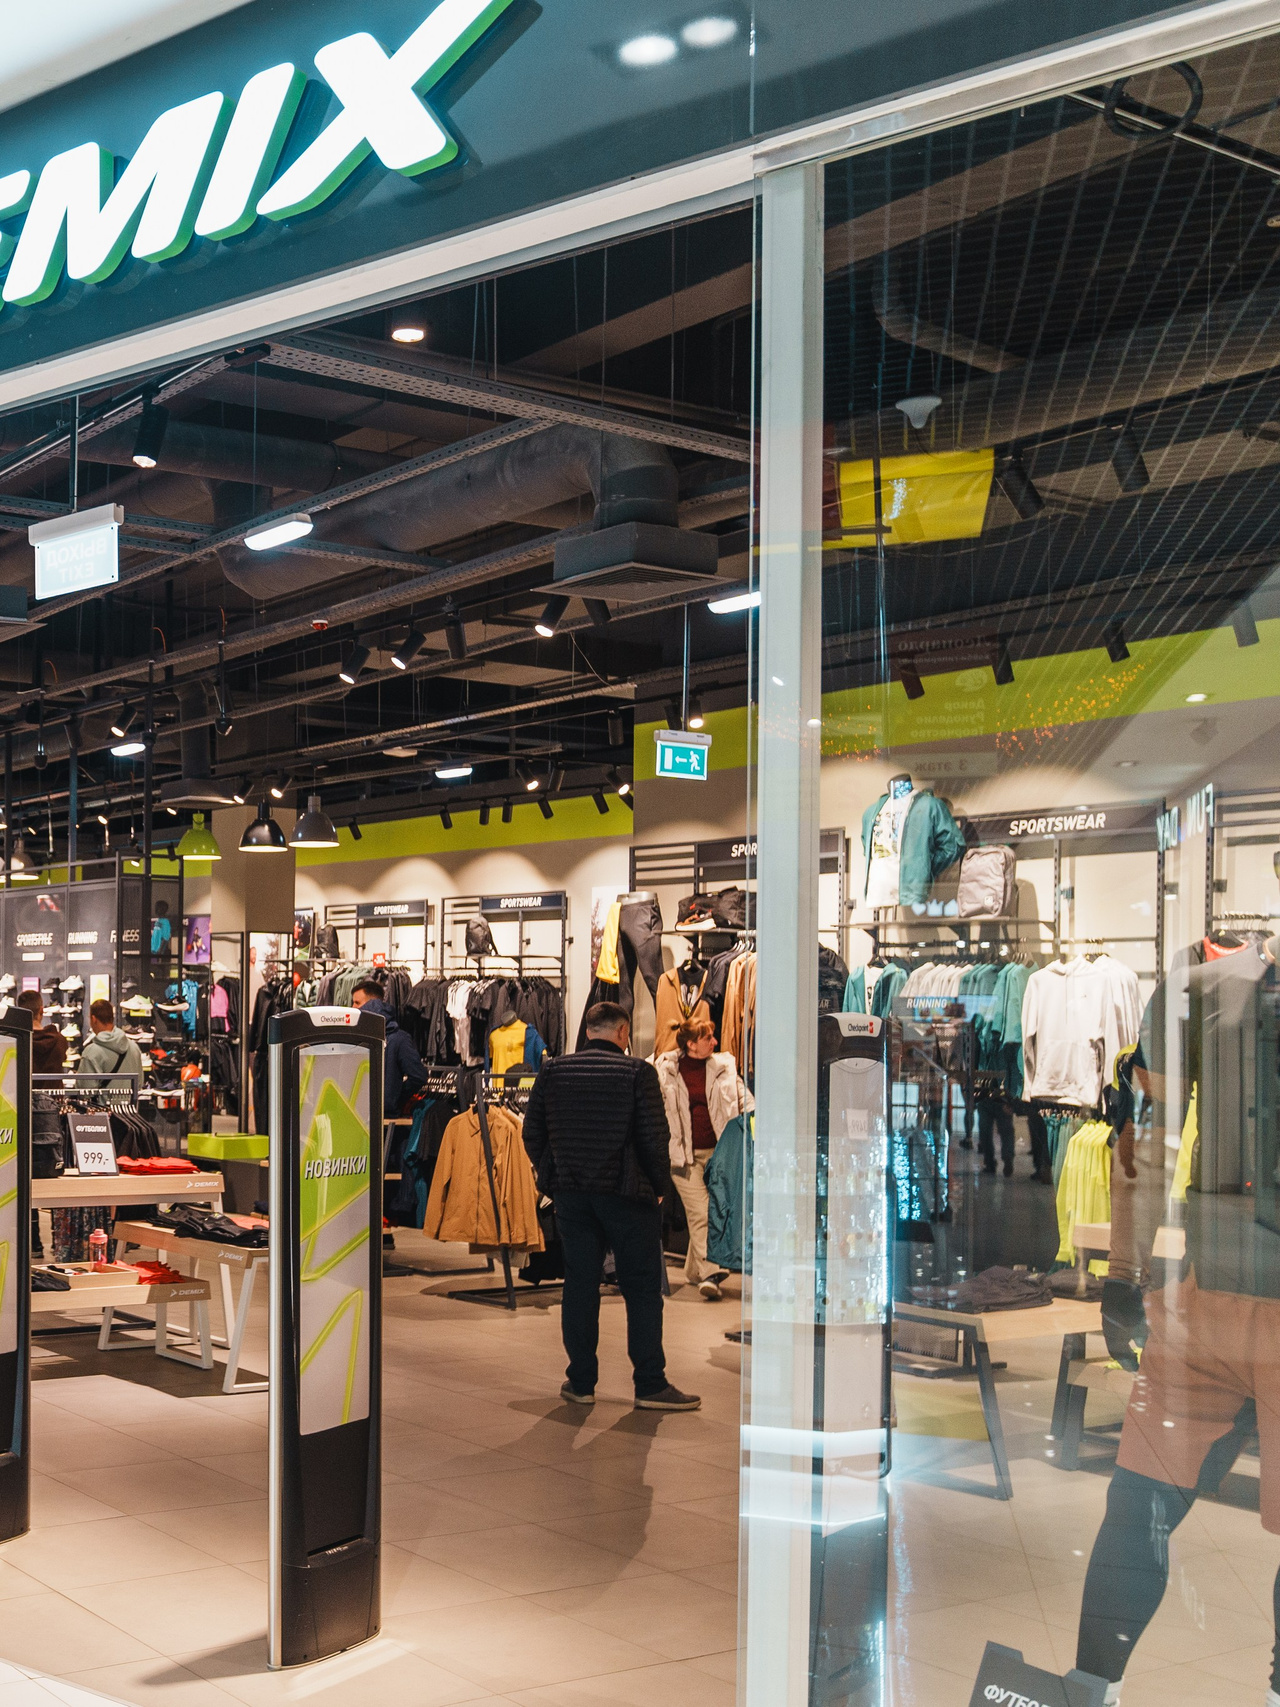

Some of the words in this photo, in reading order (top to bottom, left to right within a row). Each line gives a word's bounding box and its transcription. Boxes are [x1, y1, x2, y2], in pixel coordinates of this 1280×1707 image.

[1008, 812, 1106, 836] SPORTSWEAR
[500, 896, 542, 909] SPORTSWEAR
[373, 904, 409, 915] SPORTSWEAR
[67, 931, 99, 945] RUNNING
[906, 998, 948, 1009] RUNNING
[320, 1015, 345, 1023] Checkpoint
[847, 1023, 869, 1034] Checkpoint
[75, 1124, 107, 1133] ФУТБОЛКИ
[83, 1151, 109, 1166] 999,-
[304, 1154, 368, 1180] НОВИНКИ
[224, 1252, 245, 1262] DEMIX
[178, 1288, 206, 1296] DEMIX
[983, 1684, 1052, 1707] ФУТБО
